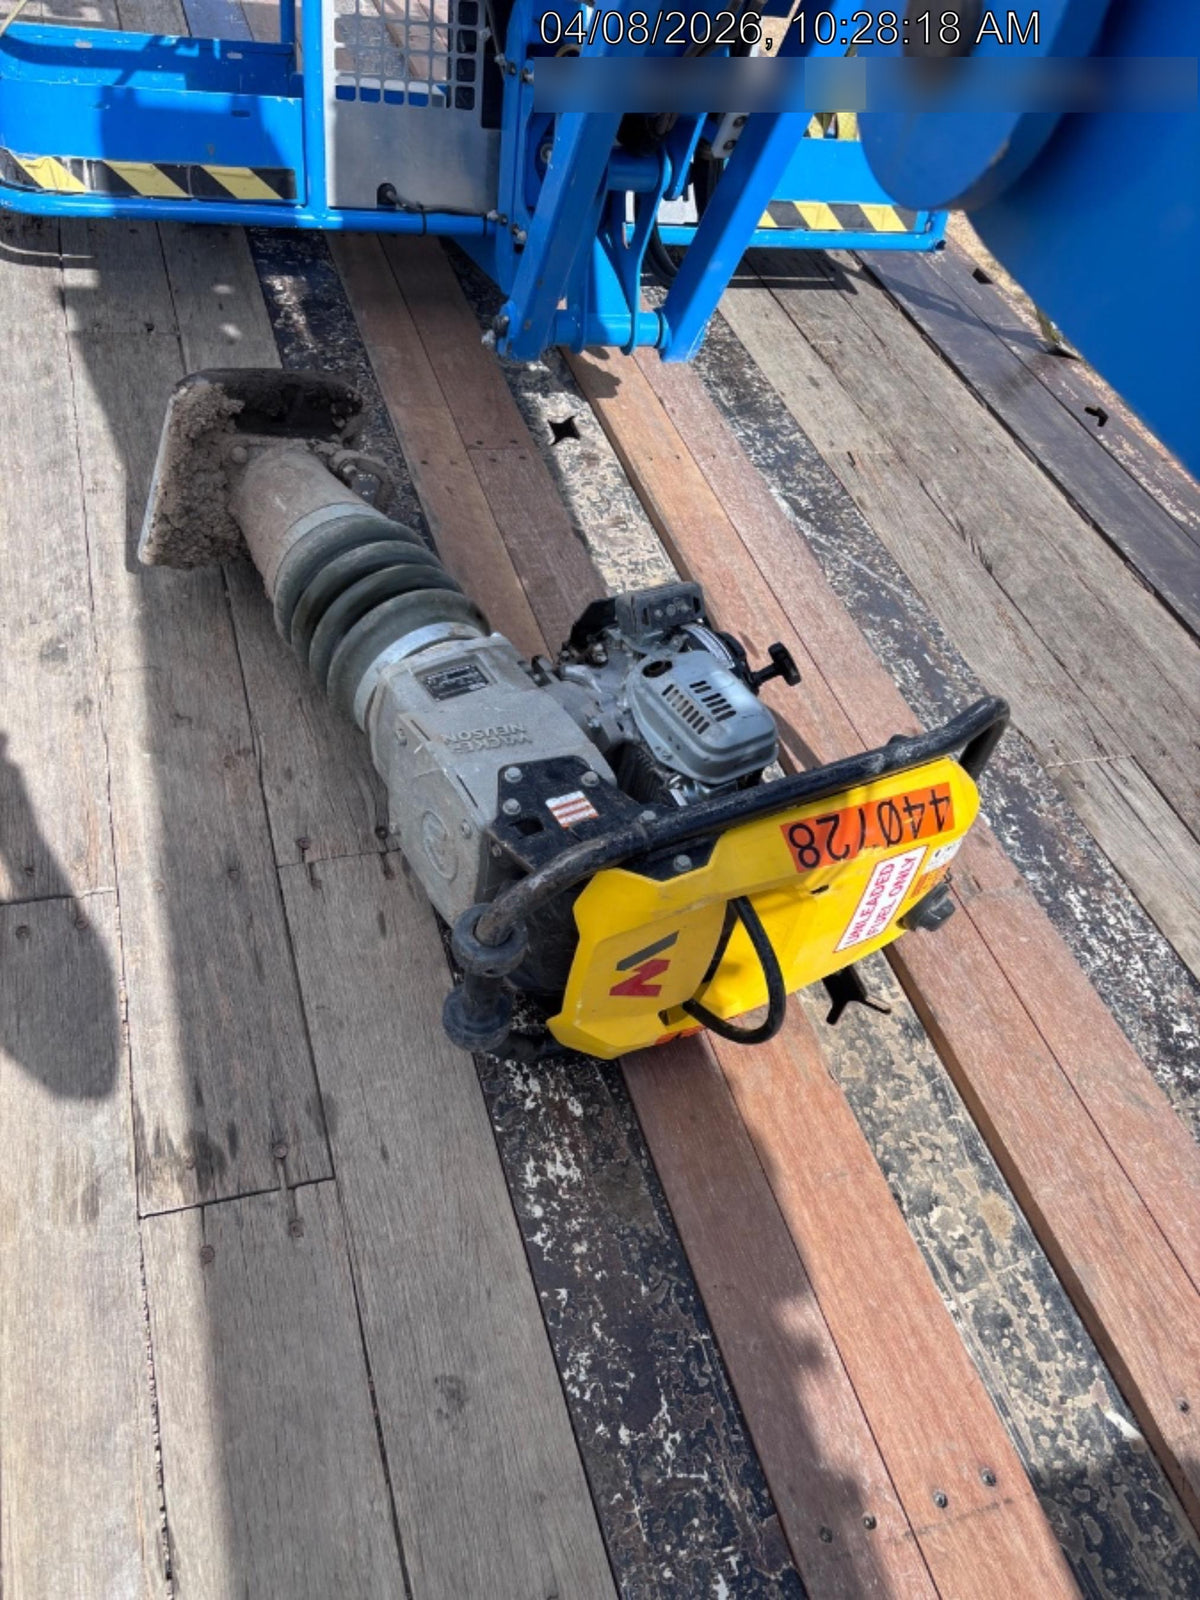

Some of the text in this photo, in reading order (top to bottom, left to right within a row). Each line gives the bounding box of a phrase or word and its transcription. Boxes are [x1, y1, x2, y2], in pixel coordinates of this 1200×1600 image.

[845, 863, 896, 945] UNLEADED
[866, 857, 916, 936] FUEL ONLY
